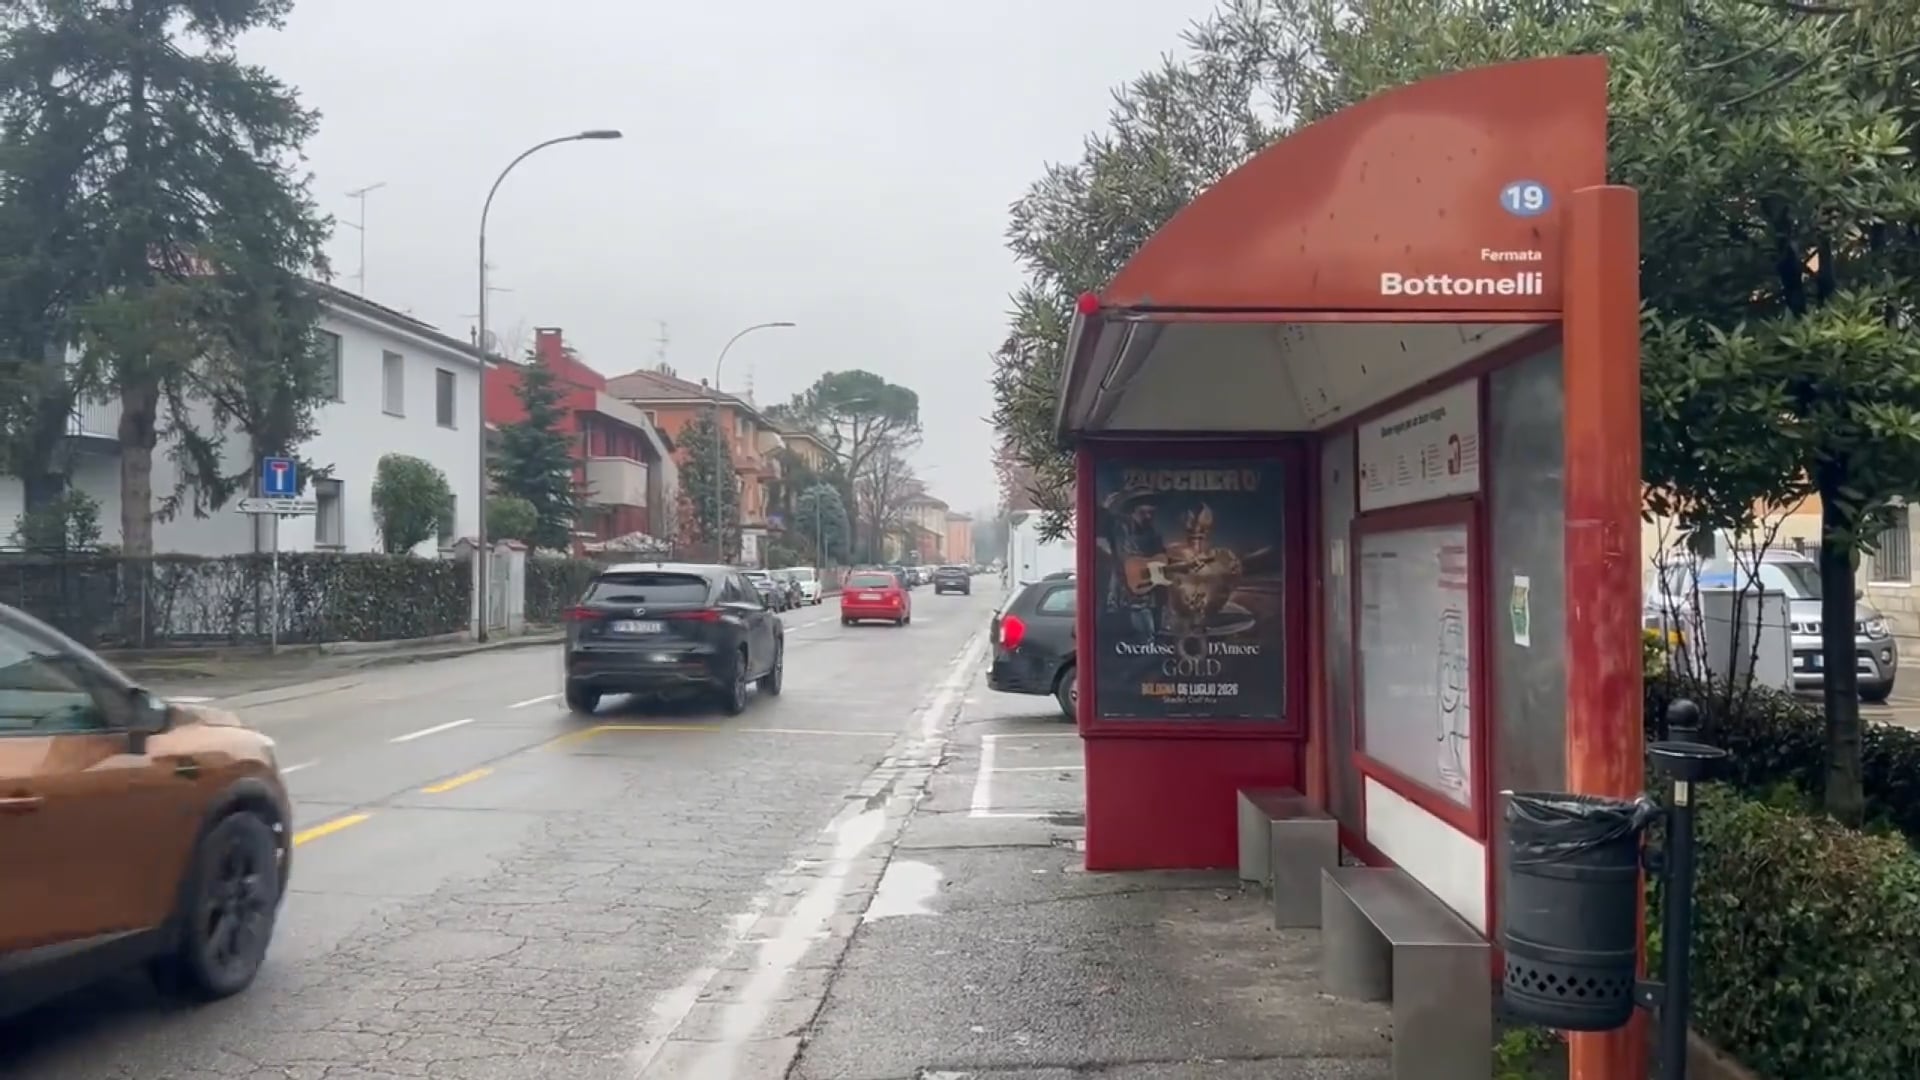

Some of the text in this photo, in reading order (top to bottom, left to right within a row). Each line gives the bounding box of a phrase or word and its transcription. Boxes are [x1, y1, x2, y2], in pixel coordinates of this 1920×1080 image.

[1507, 185, 1543, 210] 19
[1481, 248, 1542, 261] Fermata
[1380, 272, 1543, 296] Bottonelli
[1115, 641, 1175, 655] Overdose
[1162, 658, 1222, 677] GOLD
[1189, 683, 1216, 696] LUGLIO
